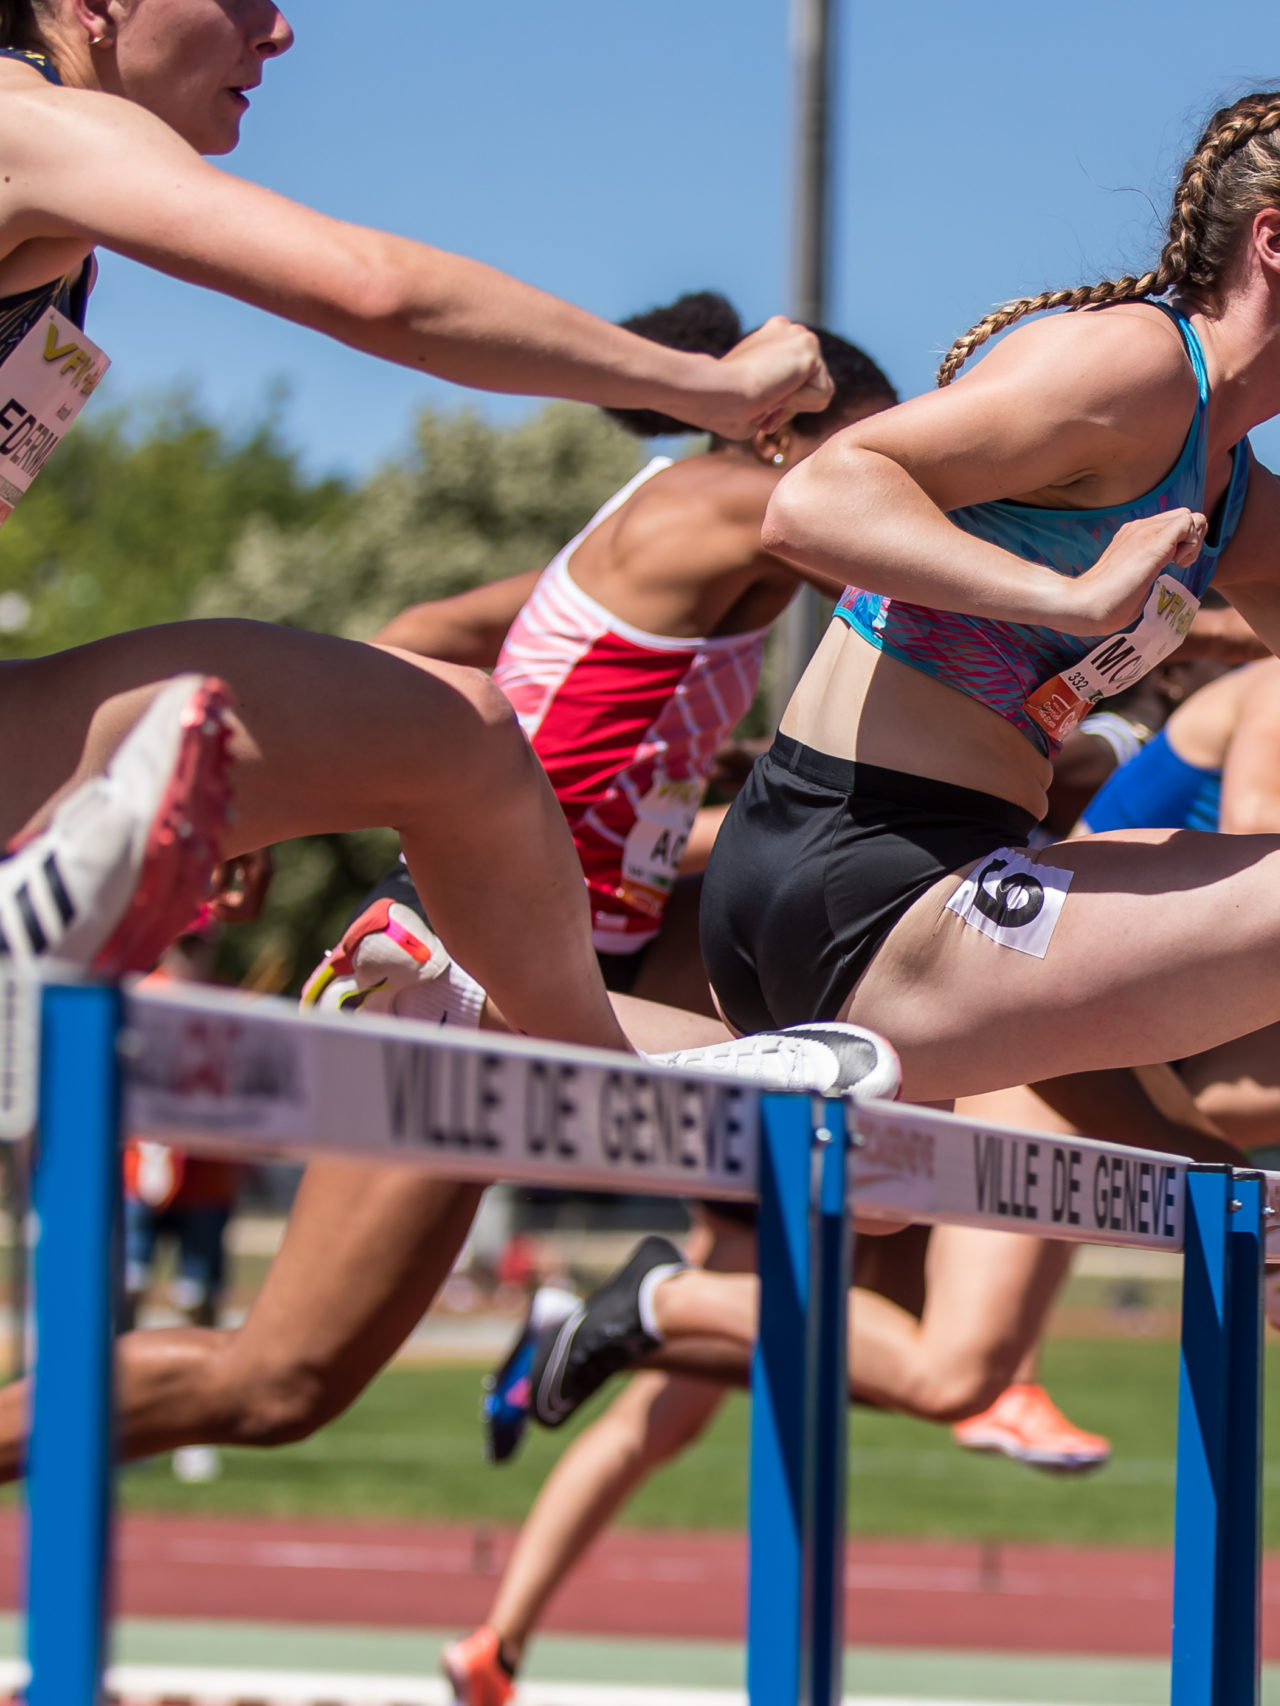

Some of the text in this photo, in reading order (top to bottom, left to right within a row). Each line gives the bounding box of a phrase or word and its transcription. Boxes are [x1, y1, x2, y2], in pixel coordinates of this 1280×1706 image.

[1068, 672, 1089, 691] 332
[973, 858, 1044, 928] 6
[380, 1039, 500, 1151] VILLE
[524, 1059, 578, 1160] DE
[973, 1132, 1039, 1219] VILLE
[1051, 1147, 1081, 1225] DE
[1093, 1154, 1177, 1237] GENEVE
